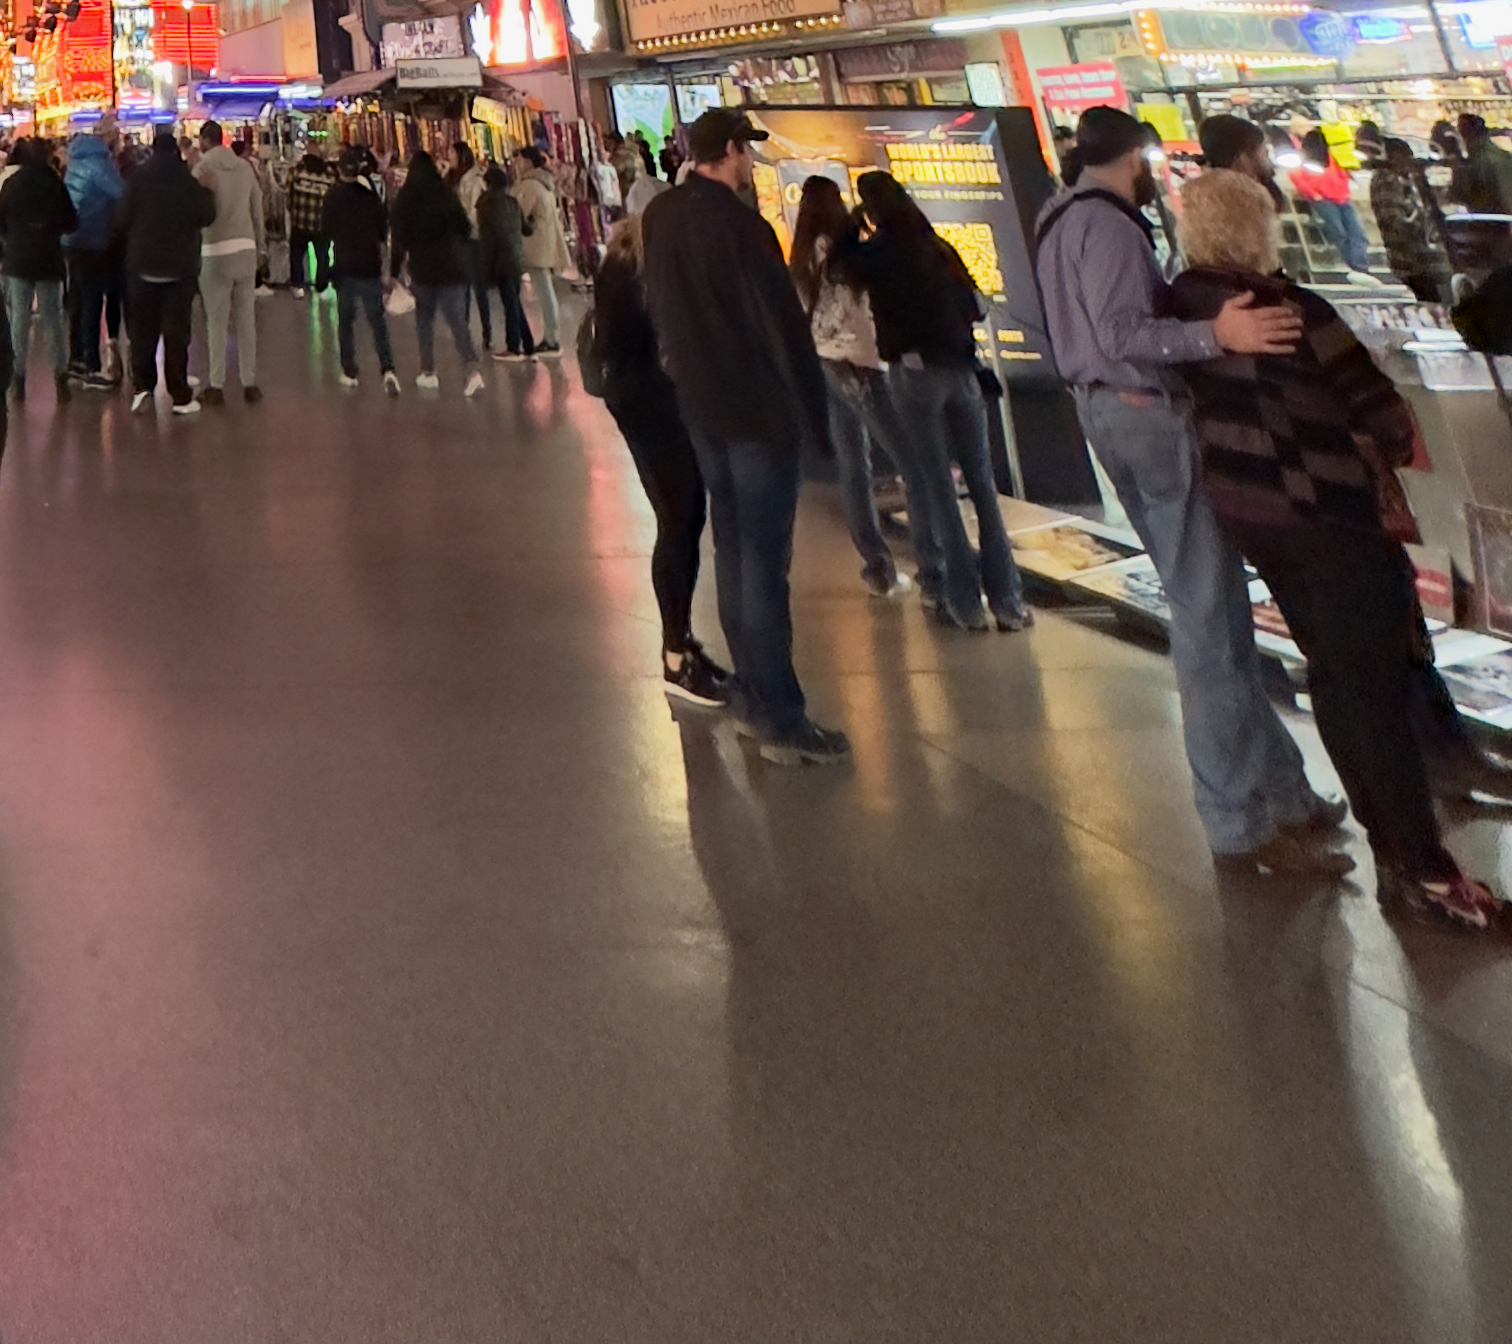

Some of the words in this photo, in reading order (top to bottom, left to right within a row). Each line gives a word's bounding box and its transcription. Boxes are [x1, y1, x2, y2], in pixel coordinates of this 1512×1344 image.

[656, 7, 707, 33] Authentic
[709, 0, 759, 23] Mexican
[885, 142, 941, 160] WORLD'S
[941, 142, 995, 161] LARGEST
[890, 160, 1002, 184] SPORTSBOOK
